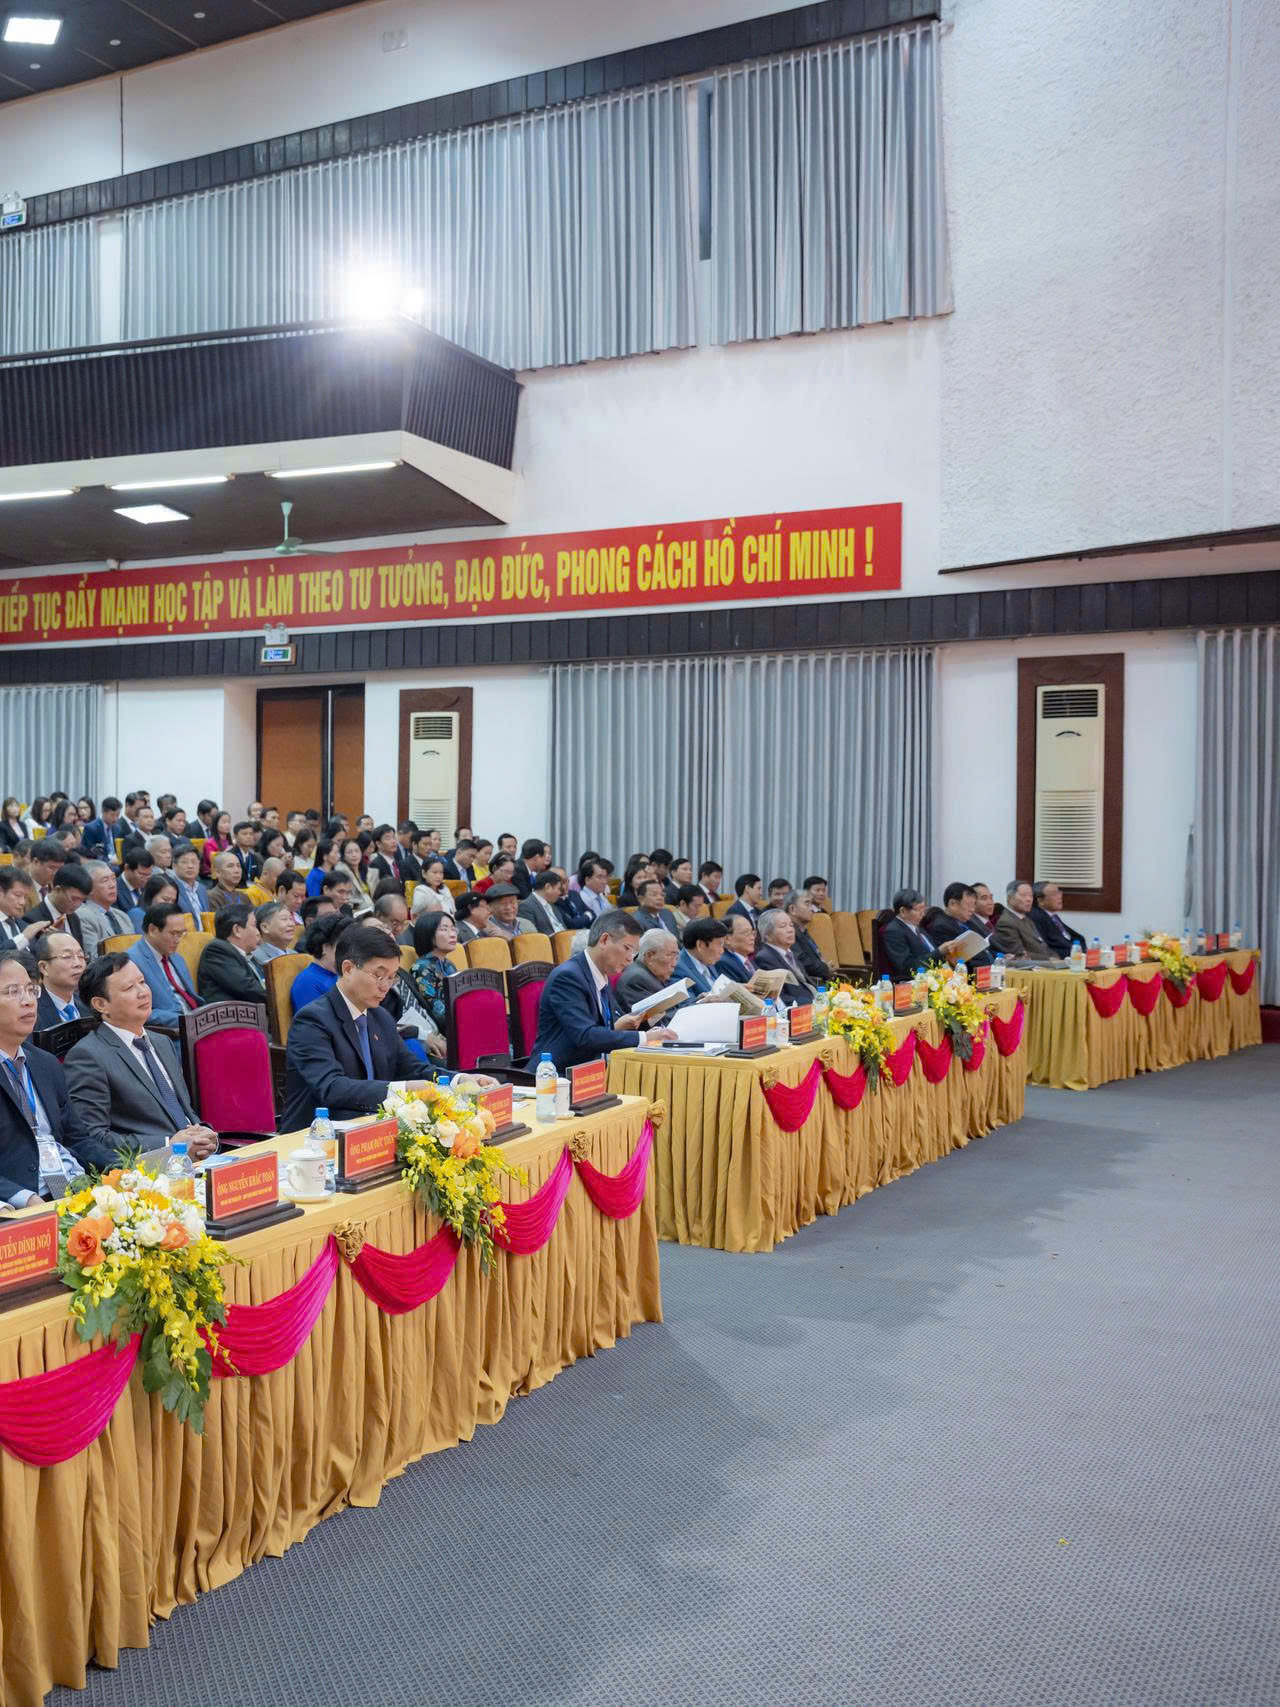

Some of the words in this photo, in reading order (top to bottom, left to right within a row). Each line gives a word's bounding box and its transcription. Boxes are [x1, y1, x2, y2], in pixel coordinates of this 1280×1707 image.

[32, 591, 61, 639] TỤC
[65, 573, 97, 629] ĐẨY
[100, 585, 149, 635] MẠNH
[153, 581, 187, 632] HỌC
[192, 570, 224, 630] TẬP
[228, 565, 251, 619] VÀ
[256, 563, 294, 617] LÀM
[299, 569, 344, 614] THEO
[349, 566, 375, 611] TƯ
[378, 549, 449, 610] TƯỞNG,
[455, 556, 495, 612] ĐẠO
[501, 541, 550, 603] ĐỨC,
[556, 545, 631, 596] PHONG
[636, 529, 697, 592] CÁCH
[703, 517, 736, 586] HỒ
[742, 519, 782, 584] CHÍ
[789, 527, 855, 581] MINH
[865, 526, 874, 576] !
